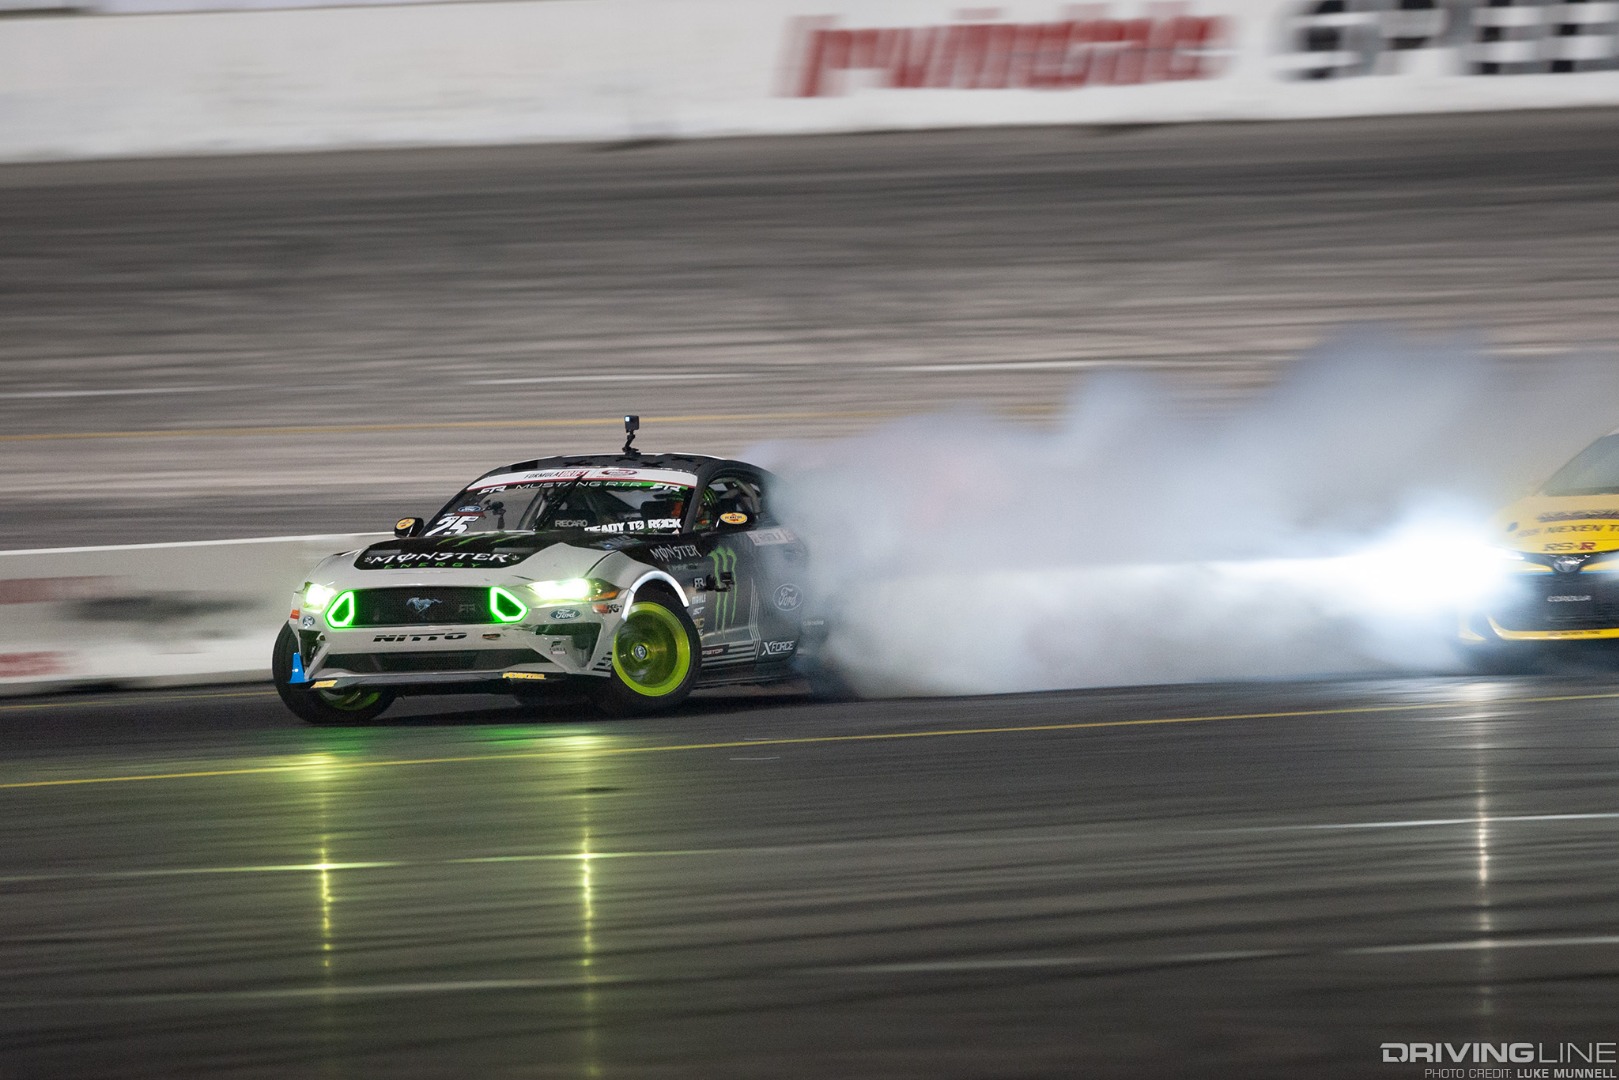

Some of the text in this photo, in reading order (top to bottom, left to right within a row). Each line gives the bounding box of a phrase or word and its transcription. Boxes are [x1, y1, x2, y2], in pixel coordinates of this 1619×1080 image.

[605, 480, 642, 489] RTR
[424, 516, 480, 537] 25
[555, 519, 588, 528] RECARO
[627, 520, 644, 531] TO
[648, 518, 682, 529] ROCK
[1546, 524, 1605, 533] NEXEN
[367, 551, 511, 564] MONSTER
[384, 562, 481, 570] ENERGY
[555, 608, 577, 619] Ford
[373, 632, 468, 642] NITTO
